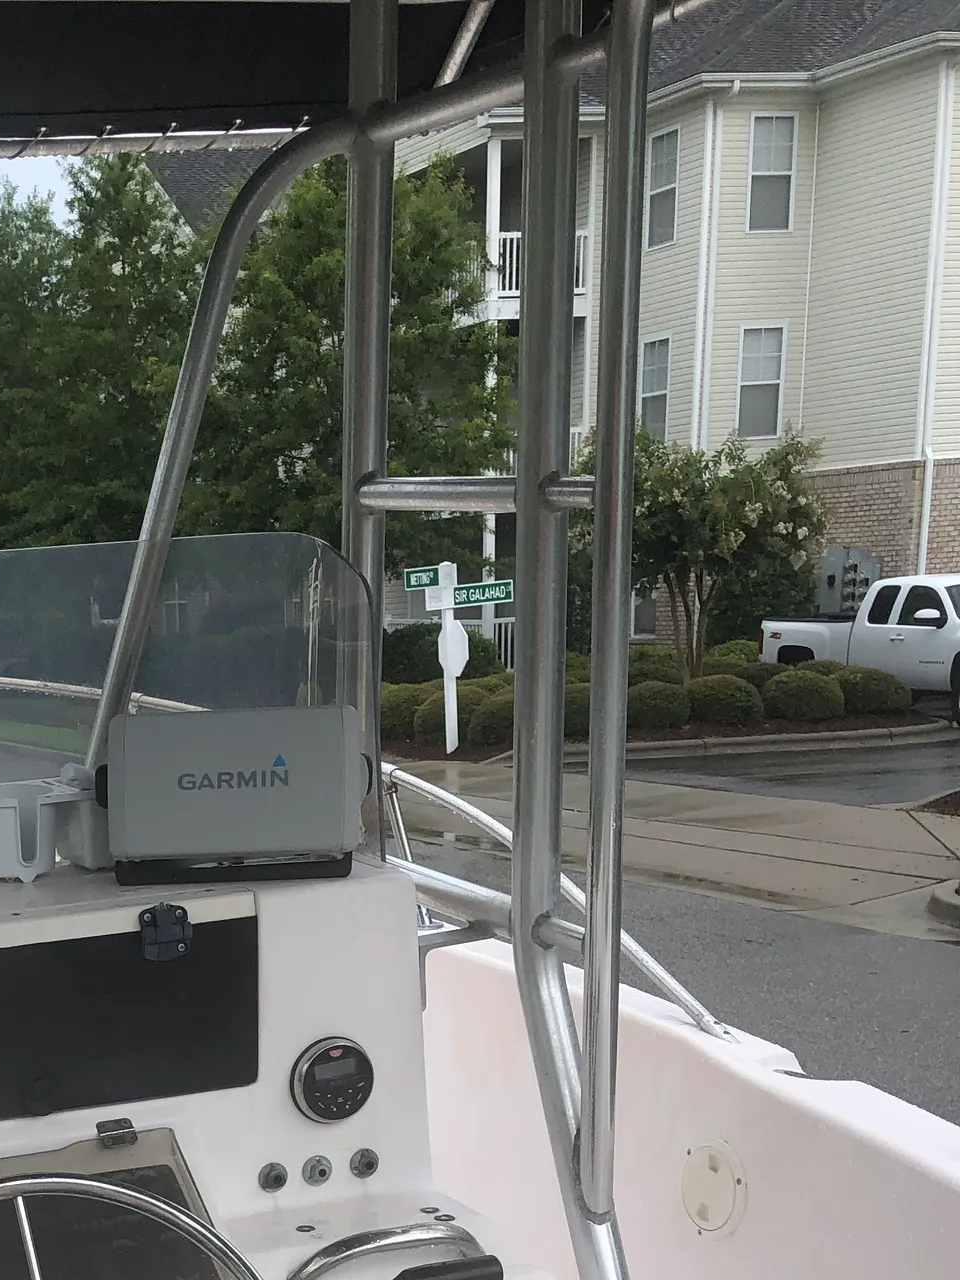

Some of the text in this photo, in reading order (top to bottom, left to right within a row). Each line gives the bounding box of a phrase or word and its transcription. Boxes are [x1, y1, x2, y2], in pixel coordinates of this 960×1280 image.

[455, 590, 468, 602] SIR
[469, 586, 506, 601] GALAHAD
[177, 770, 289, 790] GARMIN
